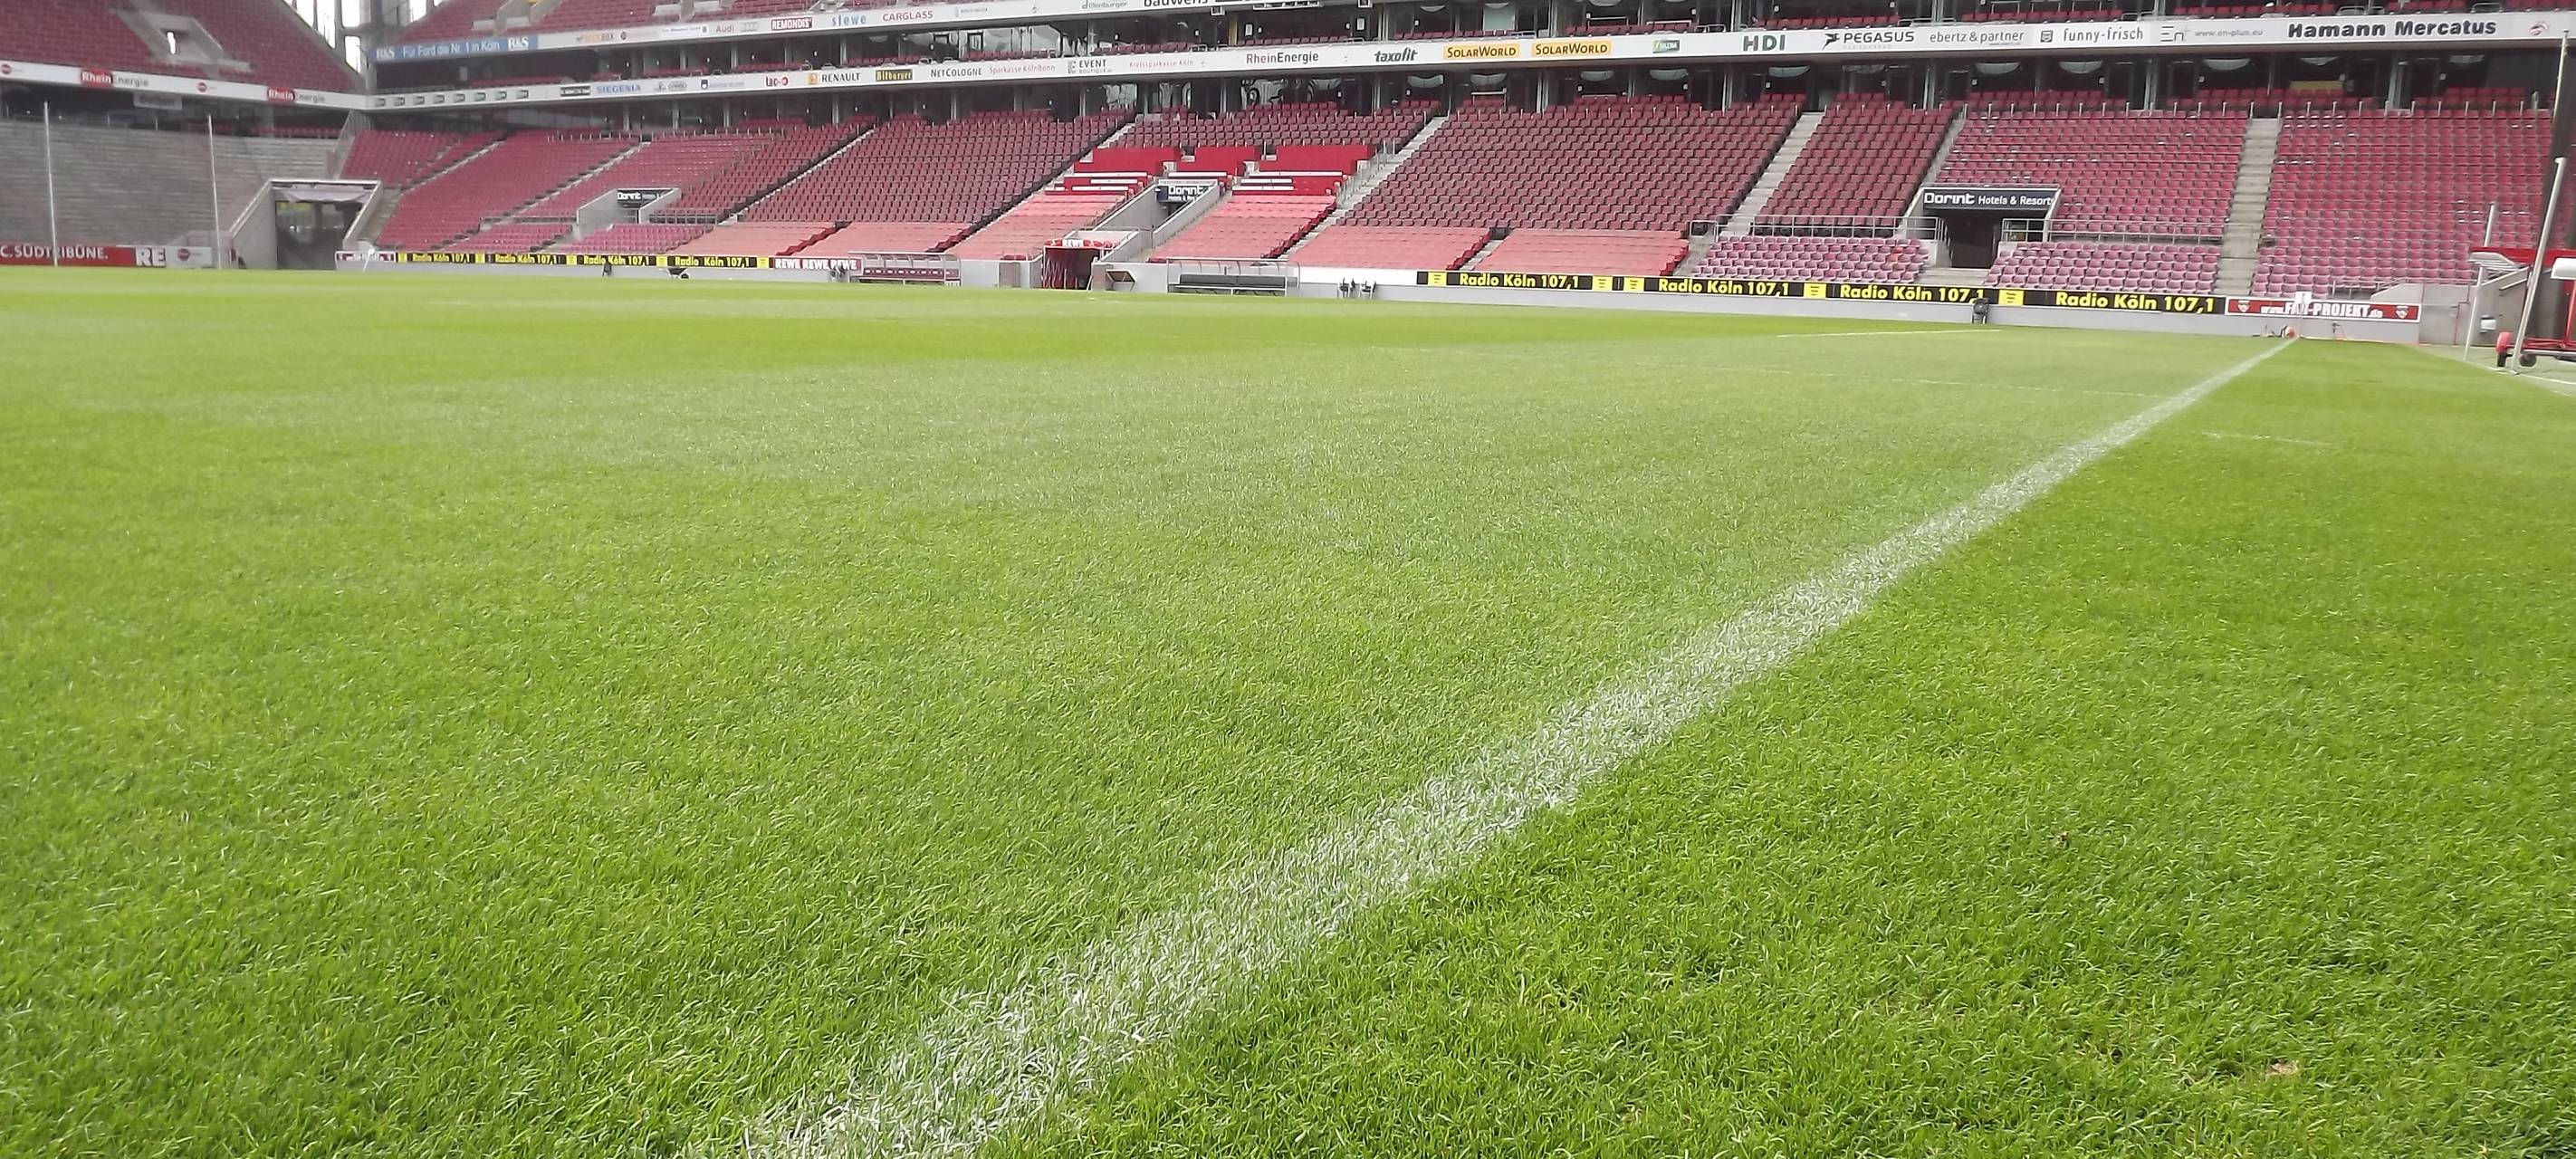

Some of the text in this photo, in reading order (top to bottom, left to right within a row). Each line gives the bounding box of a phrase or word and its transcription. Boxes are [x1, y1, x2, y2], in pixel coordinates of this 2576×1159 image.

[883, 11, 934, 22] CARGLASS
[2064, 27, 2143, 43] funny-frisch
[2288, 20, 2497, 38] Hamann Mercatus
[1743, 35, 1786, 51] HDI
[1843, 32, 1914, 43] PEGASUS
[1930, 31, 2024, 43] ebertz & partner
[1079, 60, 1106, 68] EVENT
[1247, 53, 1318, 64] RheinEnergie
[822, 72, 860, 82] RENAULT
[1924, 192, 1976, 205] Dorint
[1978, 196, 2007, 205] Hotels
[2010, 196, 2016, 204] &
[628, 255, 649, 267] 107,1
[675, 256, 750, 268] Radio Köln 107,1
[776, 259, 800, 269] REWE
[802, 259, 828, 269] REWE
[1460, 273, 1499, 286] Radio
[1504, 273, 1537, 287] Köln
[1542, 274, 1579, 290] 107,1
[1659, 279, 1789, 297] Radio Köln 107,1
[1840, 284, 1888, 299] Radio
[1893, 285, 1932, 301] Köln
[2055, 292, 2214, 314] Radio Köln 107,1
